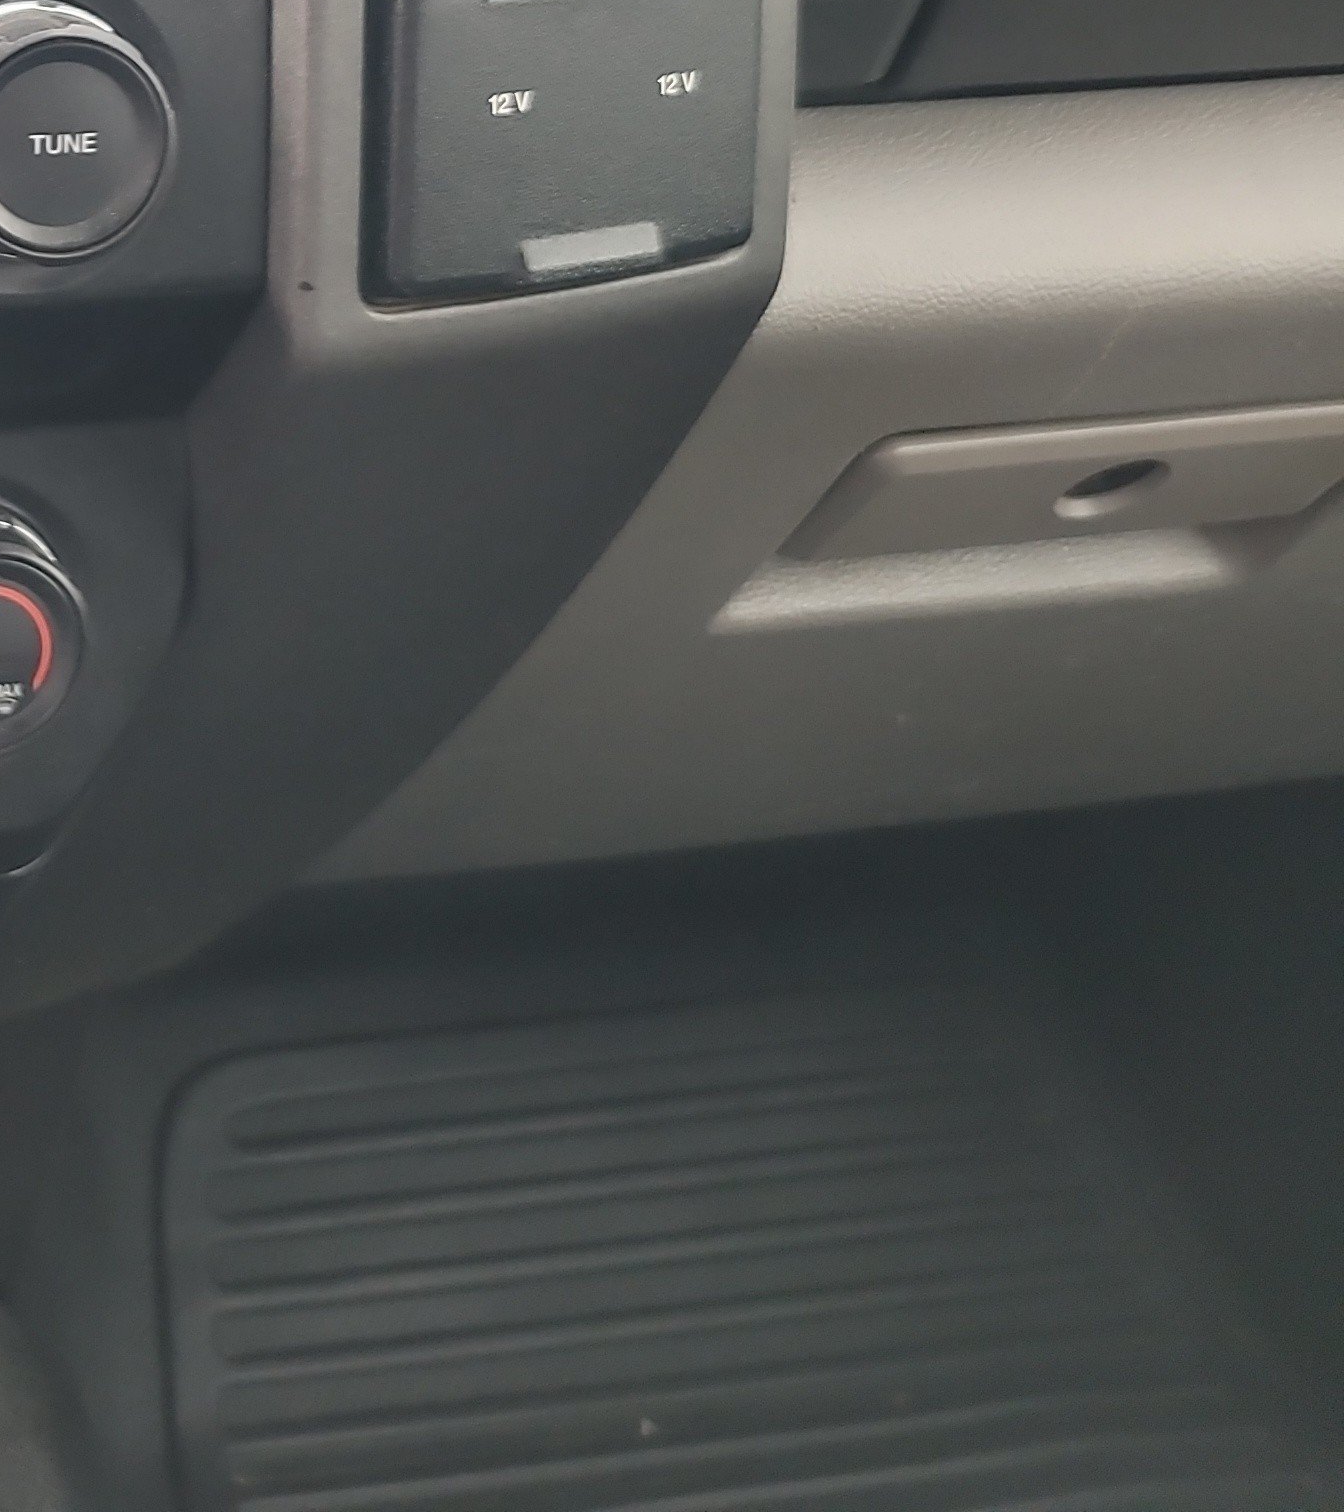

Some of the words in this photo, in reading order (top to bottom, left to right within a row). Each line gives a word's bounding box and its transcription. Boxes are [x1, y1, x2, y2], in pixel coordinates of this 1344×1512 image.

[656, 68, 702, 96] 12V
[487, 89, 536, 117] 12V
[28, 132, 98, 156] TUNE
